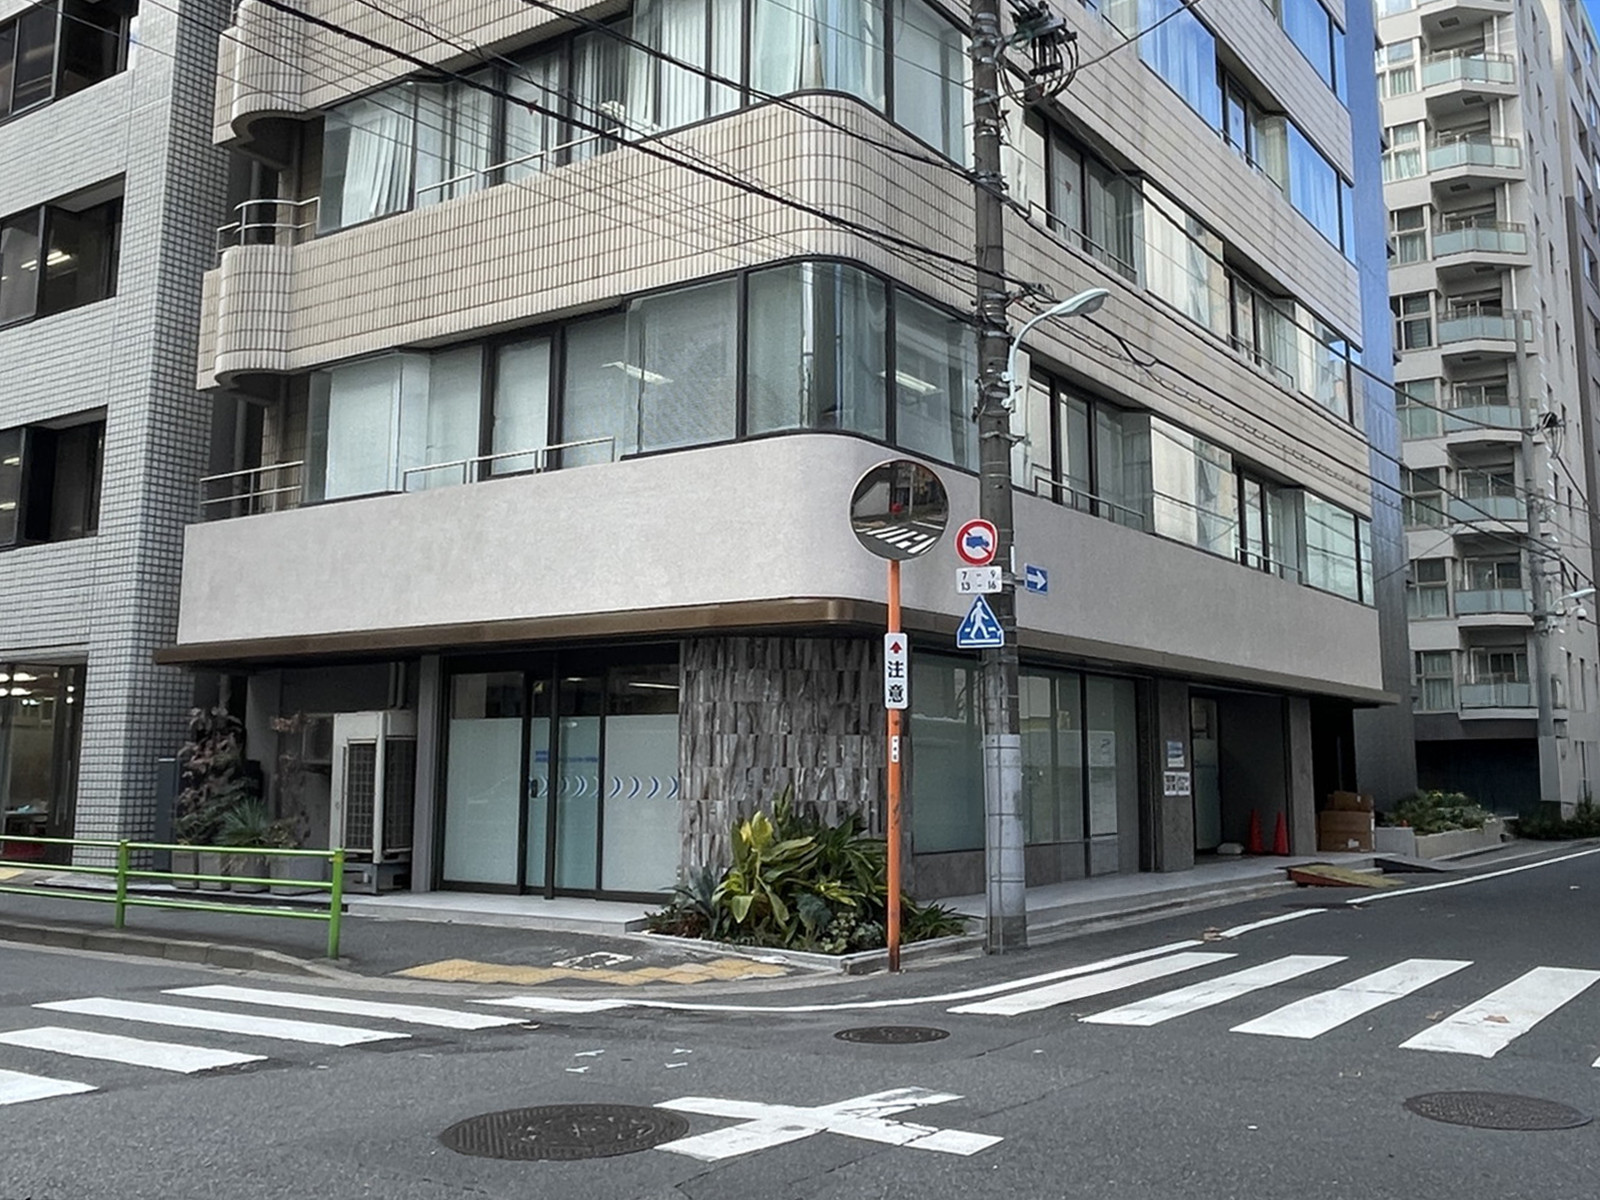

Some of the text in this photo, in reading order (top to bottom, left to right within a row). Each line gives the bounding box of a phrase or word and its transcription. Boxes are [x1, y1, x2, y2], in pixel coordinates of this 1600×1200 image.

[962, 571, 967, 580] 7
[990, 570, 996, 578] 9
[961, 582, 970, 591] 13
[988, 580, 997, 589] 16
[888, 661, 904, 702] 注意
